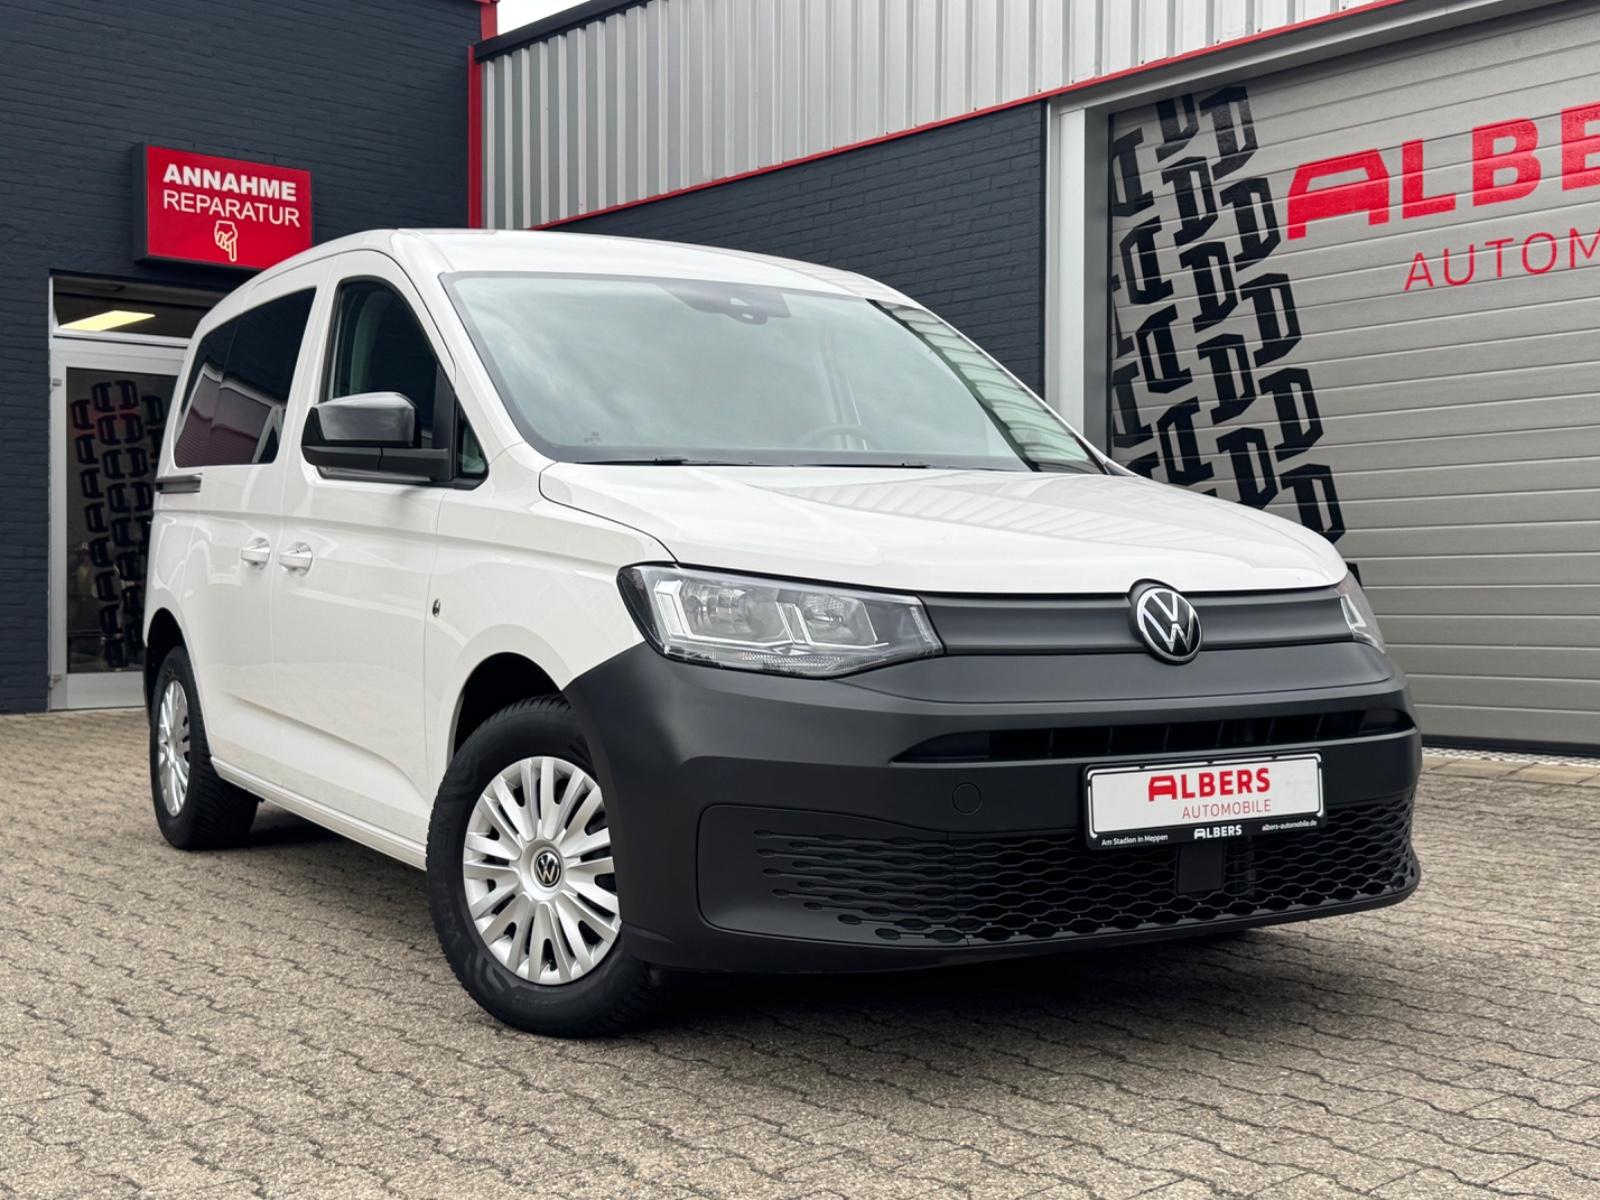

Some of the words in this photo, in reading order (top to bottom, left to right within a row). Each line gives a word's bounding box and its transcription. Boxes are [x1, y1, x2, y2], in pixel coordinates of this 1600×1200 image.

[163, 163, 297, 202] ANNAHME
[163, 189, 300, 228] REPARATUR
[1148, 767, 1271, 802] ALBERS
[1182, 799, 1272, 820] AUTOMOBILE
[1113, 835, 1137, 846] Stadion
[1144, 833, 1169, 844] Meppen
[1193, 824, 1243, 840] ALBERS
